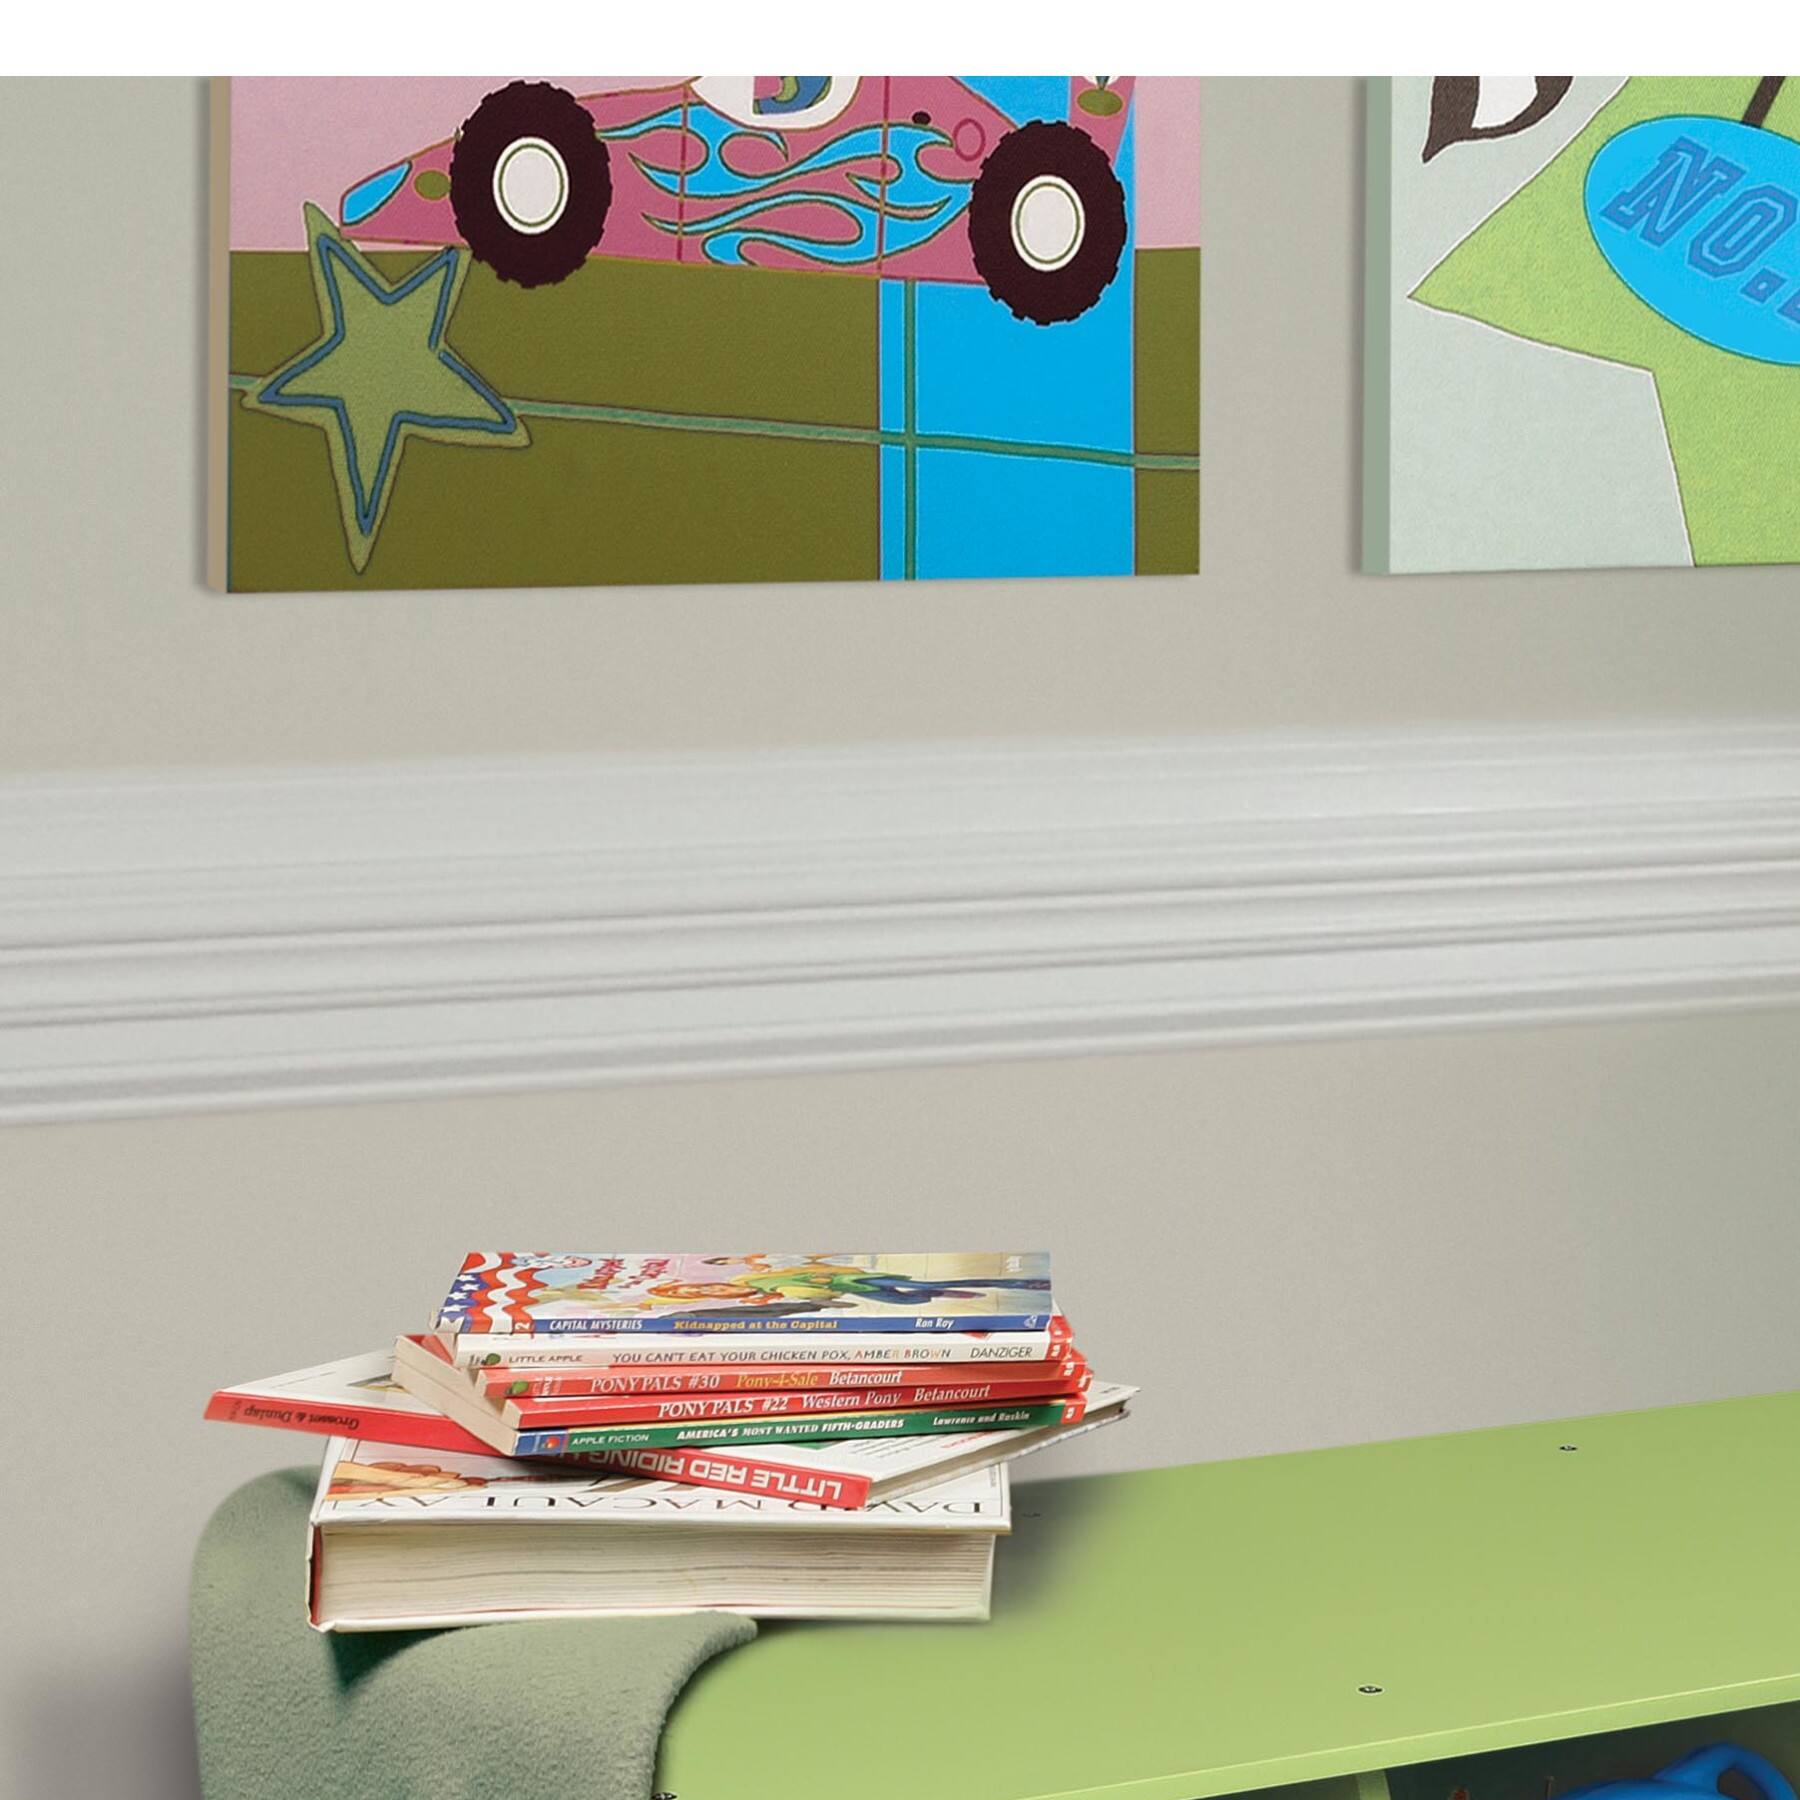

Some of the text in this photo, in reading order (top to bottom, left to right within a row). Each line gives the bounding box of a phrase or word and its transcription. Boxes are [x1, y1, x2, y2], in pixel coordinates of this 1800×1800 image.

[550, 1319, 643, 1331] CAPITAL MYSTERIES
[674, 1320, 838, 1331] Kidnapped at the Capital
[915, 1317, 954, 1330] Ron Roy
[509, 1354, 582, 1363] LITTLE APPLE
[613, 1349, 951, 1363] YOU CAN'T EAT YOUR CHICKEN POX, AMBER BROWN
[969, 1346, 1033, 1358] DANZIGER
[590, 1375, 720, 1393] PONY PALS #30
[829, 1370, 902, 1386] Betancourt
[801, 1390, 902, 1410] Western Pony
[914, 1384, 991, 1401] Betancourt
[243, 1403, 293, 1424] Dunlap
[659, 1397, 789, 1418] PONY PALS #22
[295, 1411, 307, 1420] &
[308, 1412, 360, 1431] Grosset
[978, 1412, 996, 1423] and
[676, 1418, 905, 1440] AMERICA'S MOST WANTED FIFTH-GRADERS
[571, 1433, 650, 1445] APPLE FICTION
[688, 1458, 748, 1485] RED
[750, 1468, 843, 1500] LITTLE
[358, 1496, 763, 1511] MACAULAY
